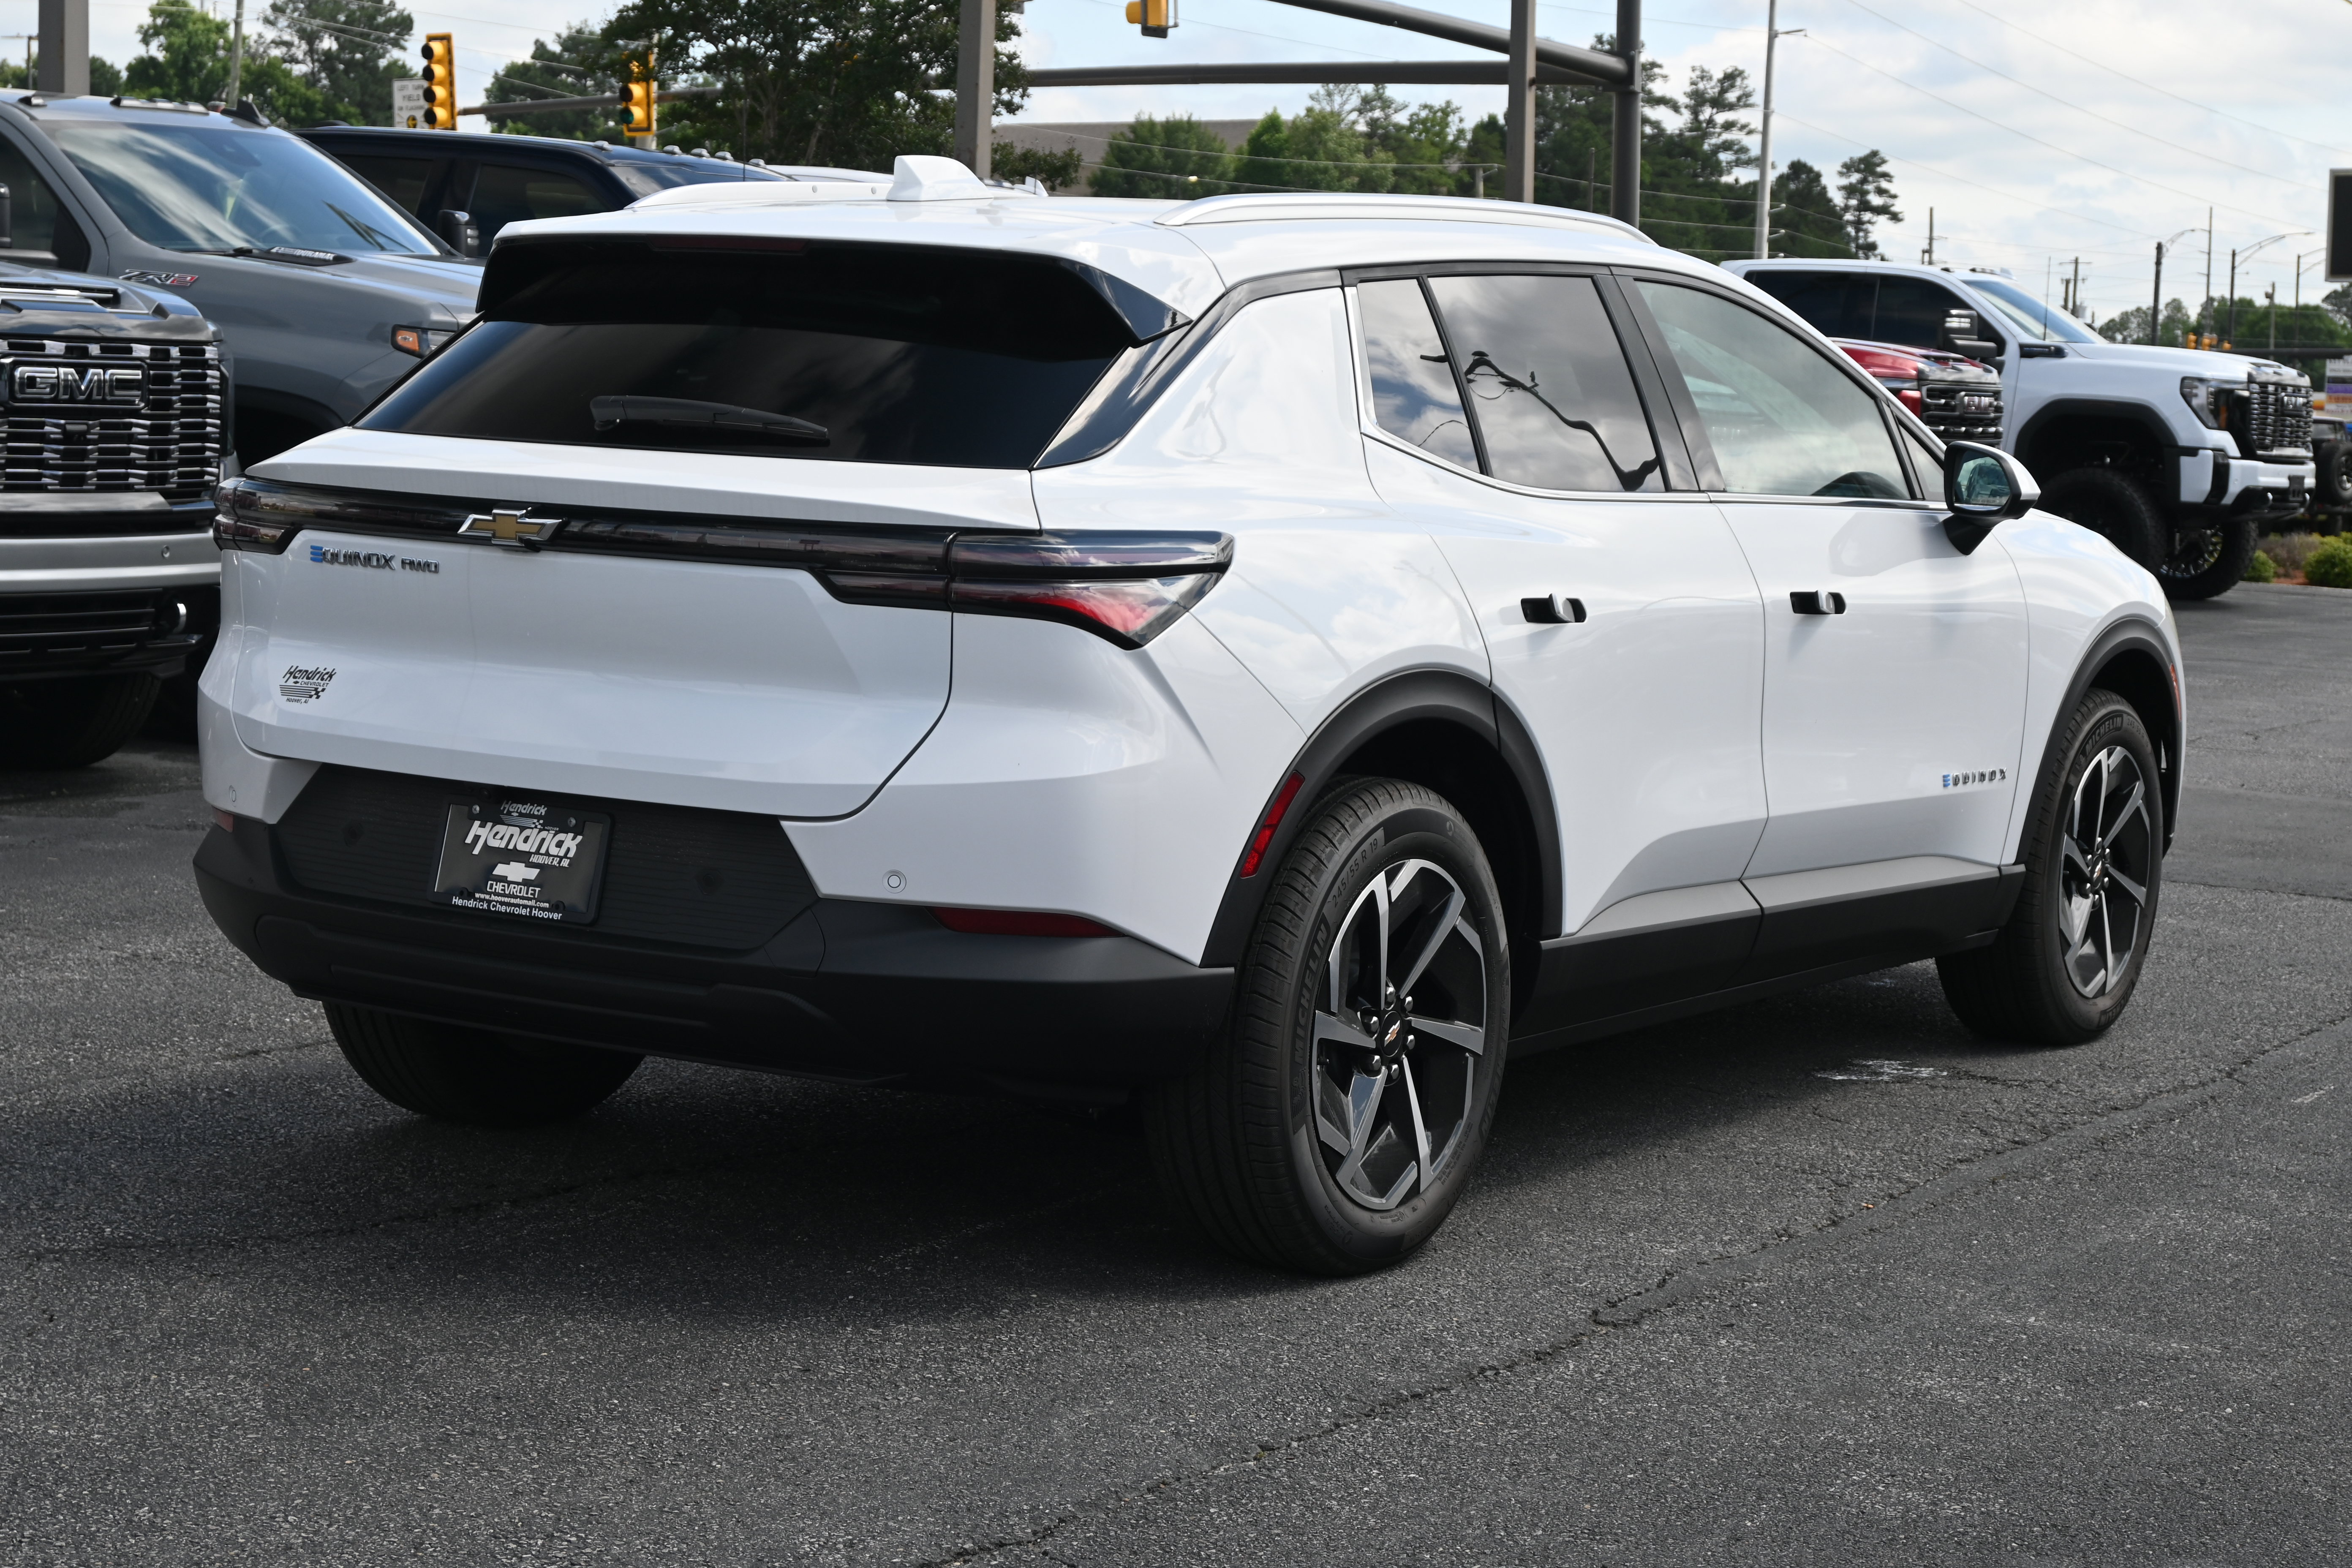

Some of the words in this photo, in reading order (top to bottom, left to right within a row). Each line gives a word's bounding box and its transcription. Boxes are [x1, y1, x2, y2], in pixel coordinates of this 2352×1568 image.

[15, 366, 142, 400] GMC
[310, 544, 396, 570] EQUINOX
[401, 556, 439, 573] AWD
[282, 665, 337, 683] Hendrick
[2085, 716, 2122, 756] MICHELIN
[1943, 767, 2007, 787] EQUINOX
[501, 800, 547, 816] Hendrick
[465, 820, 583, 858] Hendrick
[529, 854, 560, 867] HOOVER,
[560, 858, 570, 867] AL
[1332, 858, 1359, 908] 245/55
[1369, 838, 1378, 853] 19
[475, 893, 550, 908] www.hooverautomall.com
[486, 880, 541, 898] CHEVROLET
[452, 896, 488, 909] Hendrick
[490, 901, 530, 916] Chevrolet
[531, 908, 563, 920] Hoover
[1294, 923, 1328, 1065] MICHELIN
